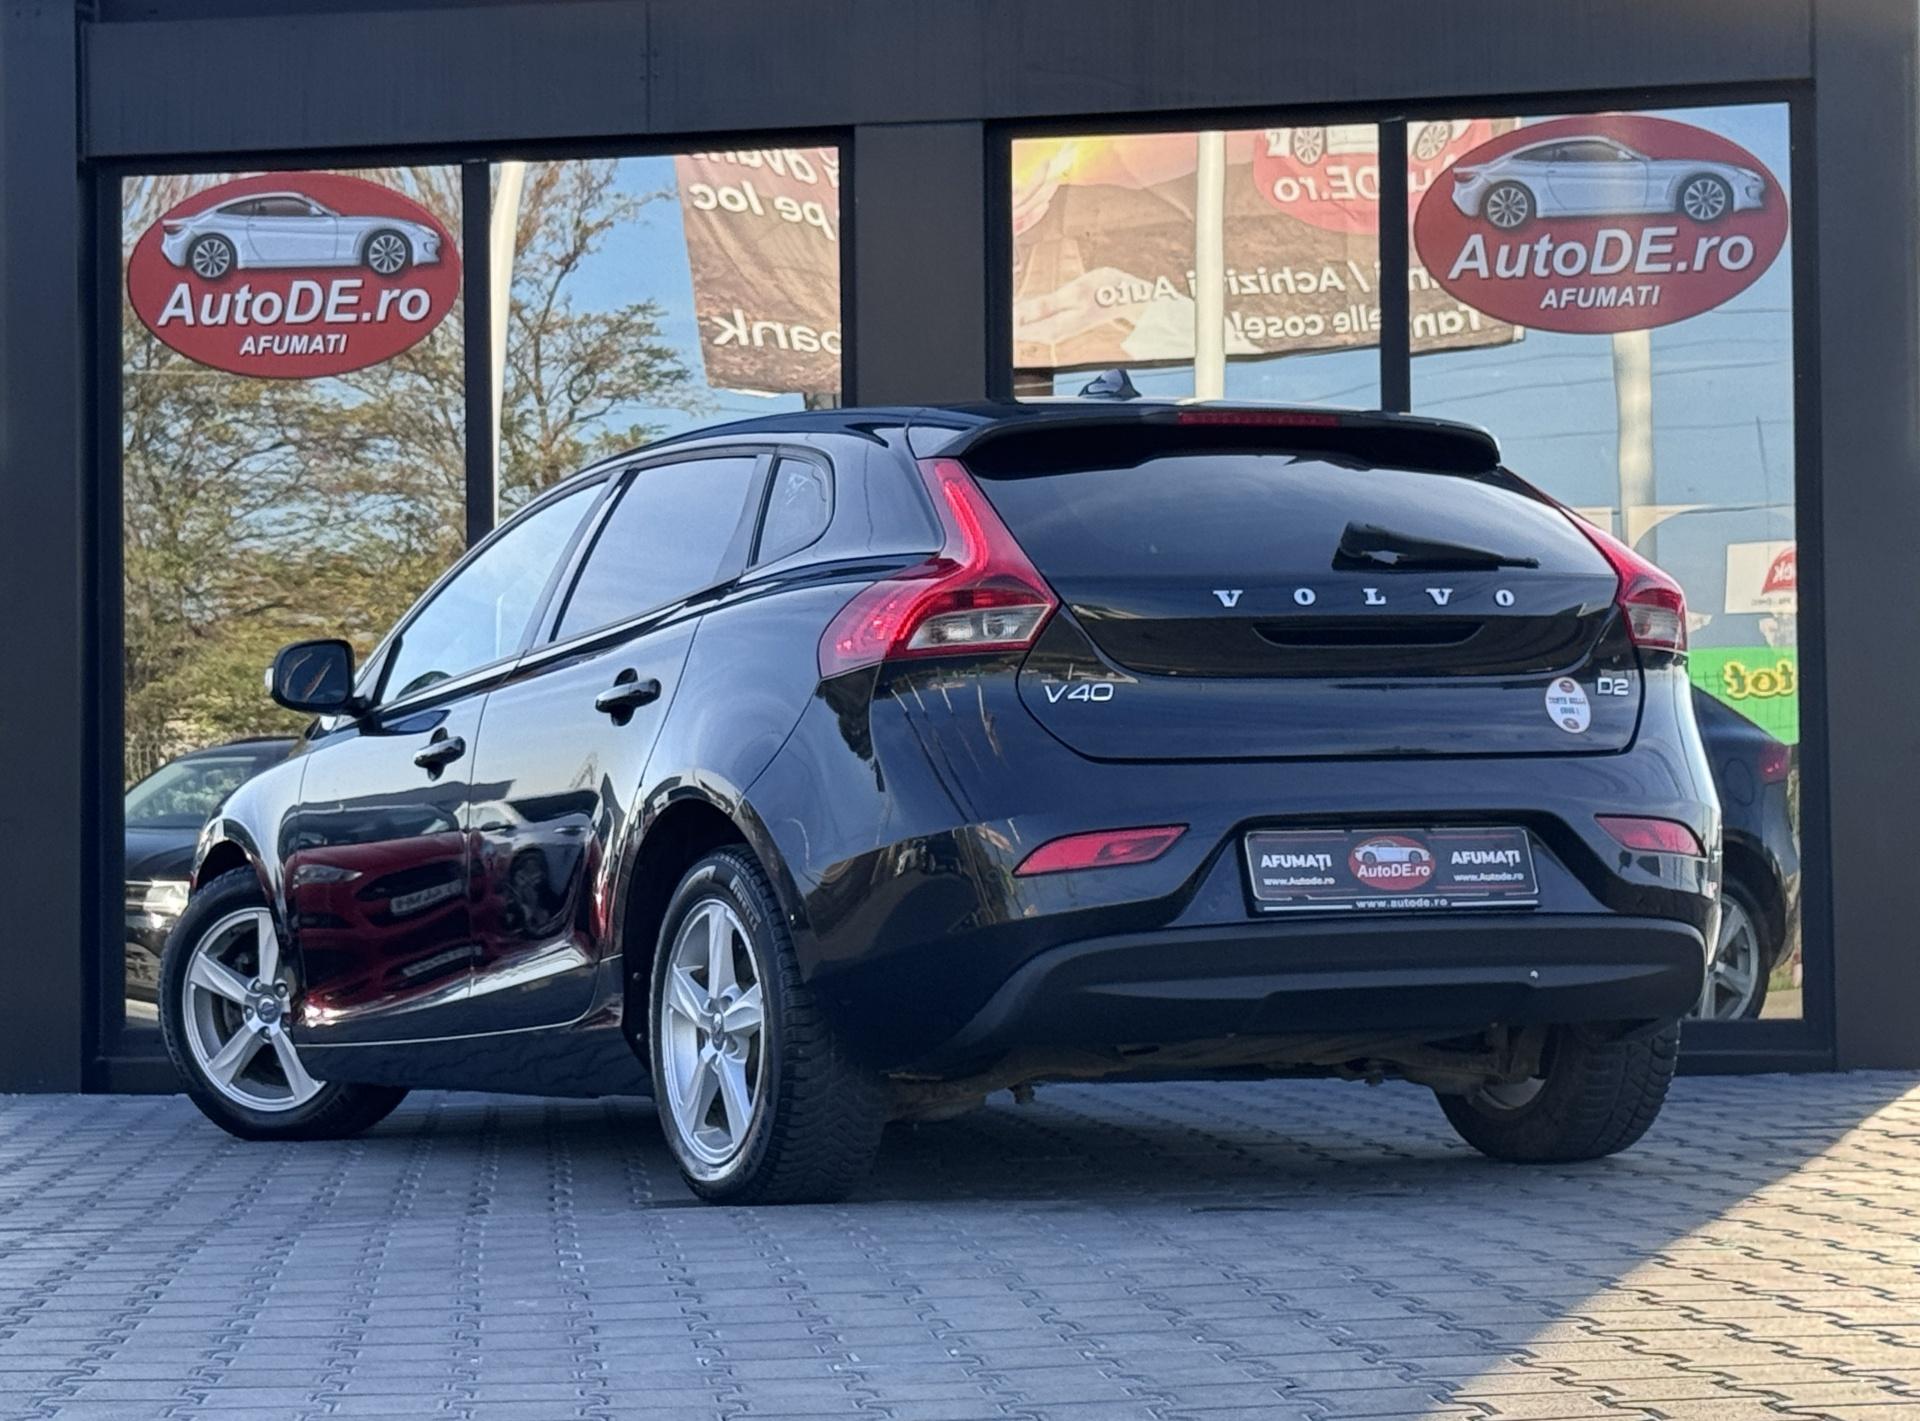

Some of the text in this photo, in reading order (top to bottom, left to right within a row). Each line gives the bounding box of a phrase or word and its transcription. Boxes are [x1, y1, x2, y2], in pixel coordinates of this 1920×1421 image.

[1448, 226, 1755, 280] AutoDE.ro
[157, 278, 431, 327] AutoDE.ro
[1539, 284, 1661, 310] AFUMATI
[239, 333, 348, 356] AFUMATI
[1213, 586, 1515, 608] VOLVO
[1043, 682, 1114, 704] V40
[1596, 676, 1629, 697] D2
[1356, 862, 1431, 879] AutoDE.ro
[1354, 897, 1449, 909] www.autode.ro
